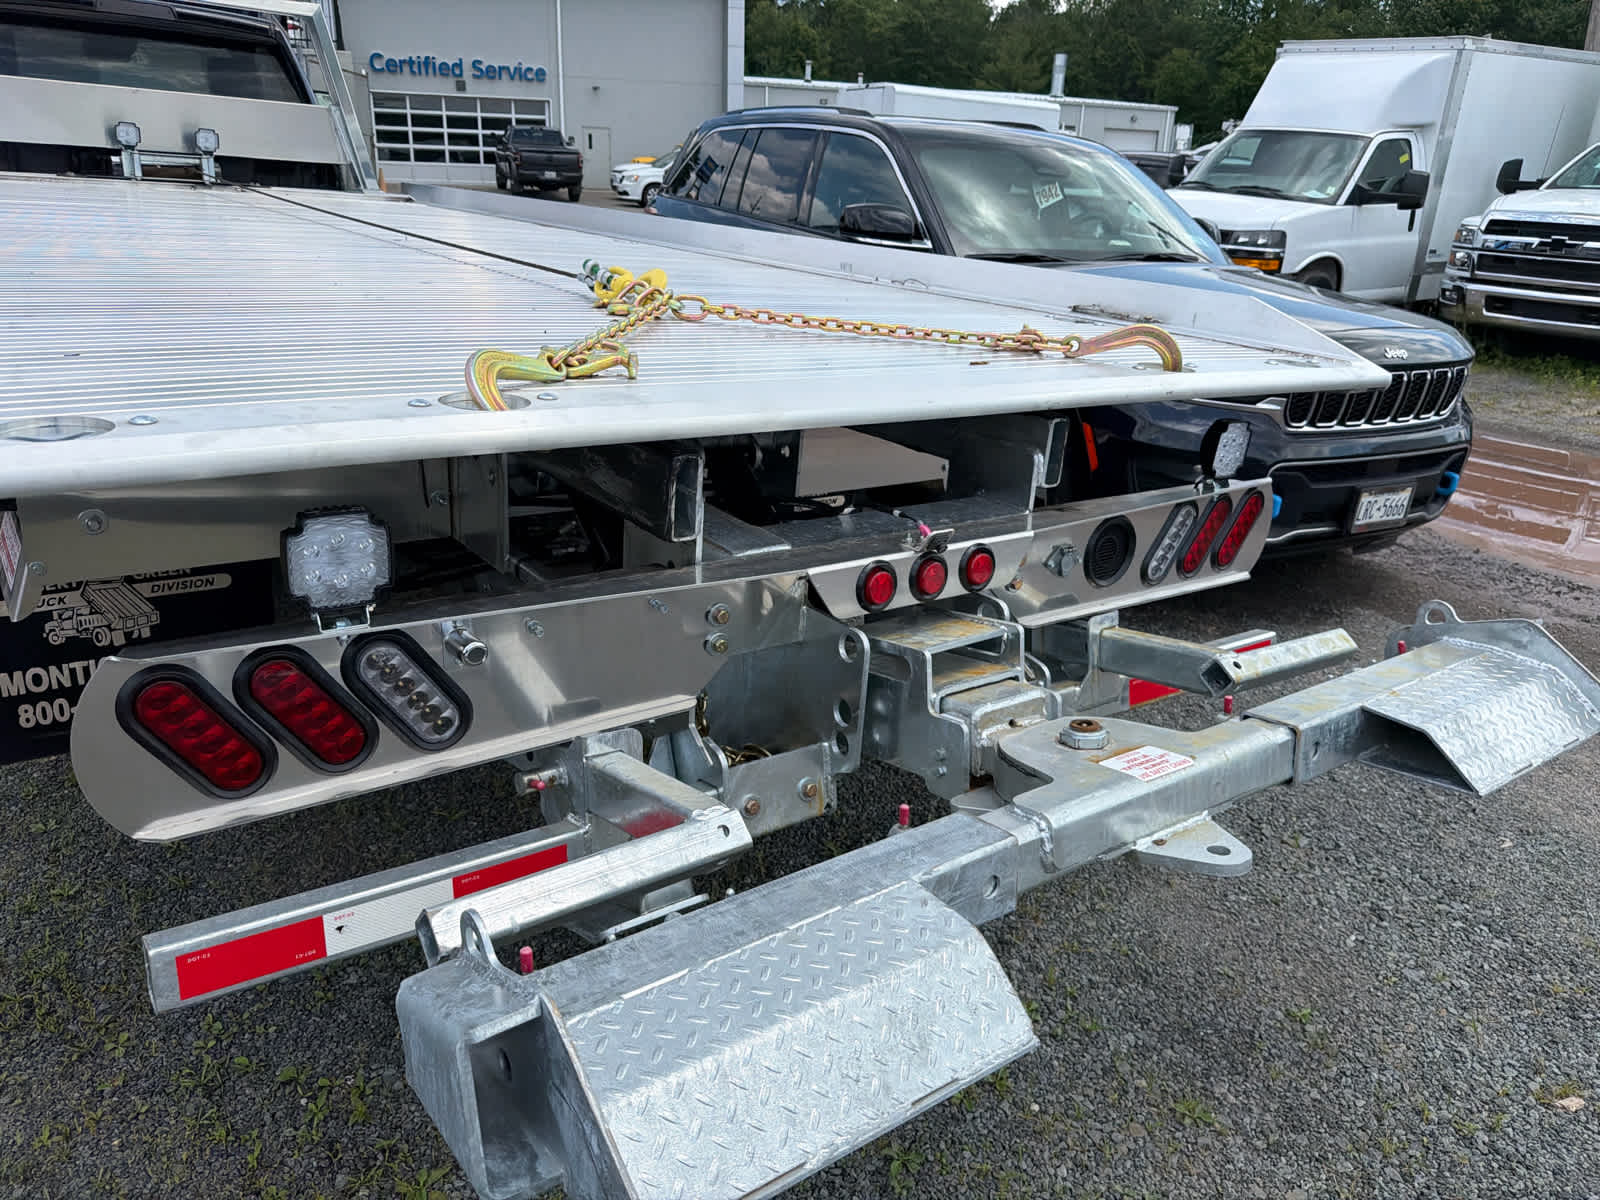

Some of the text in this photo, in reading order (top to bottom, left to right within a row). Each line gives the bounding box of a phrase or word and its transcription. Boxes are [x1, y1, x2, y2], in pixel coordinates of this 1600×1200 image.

[369, 52, 547, 82] Certified Service
[1384, 347, 1408, 360] Jeep
[151, 576, 216, 593] DIVISION
